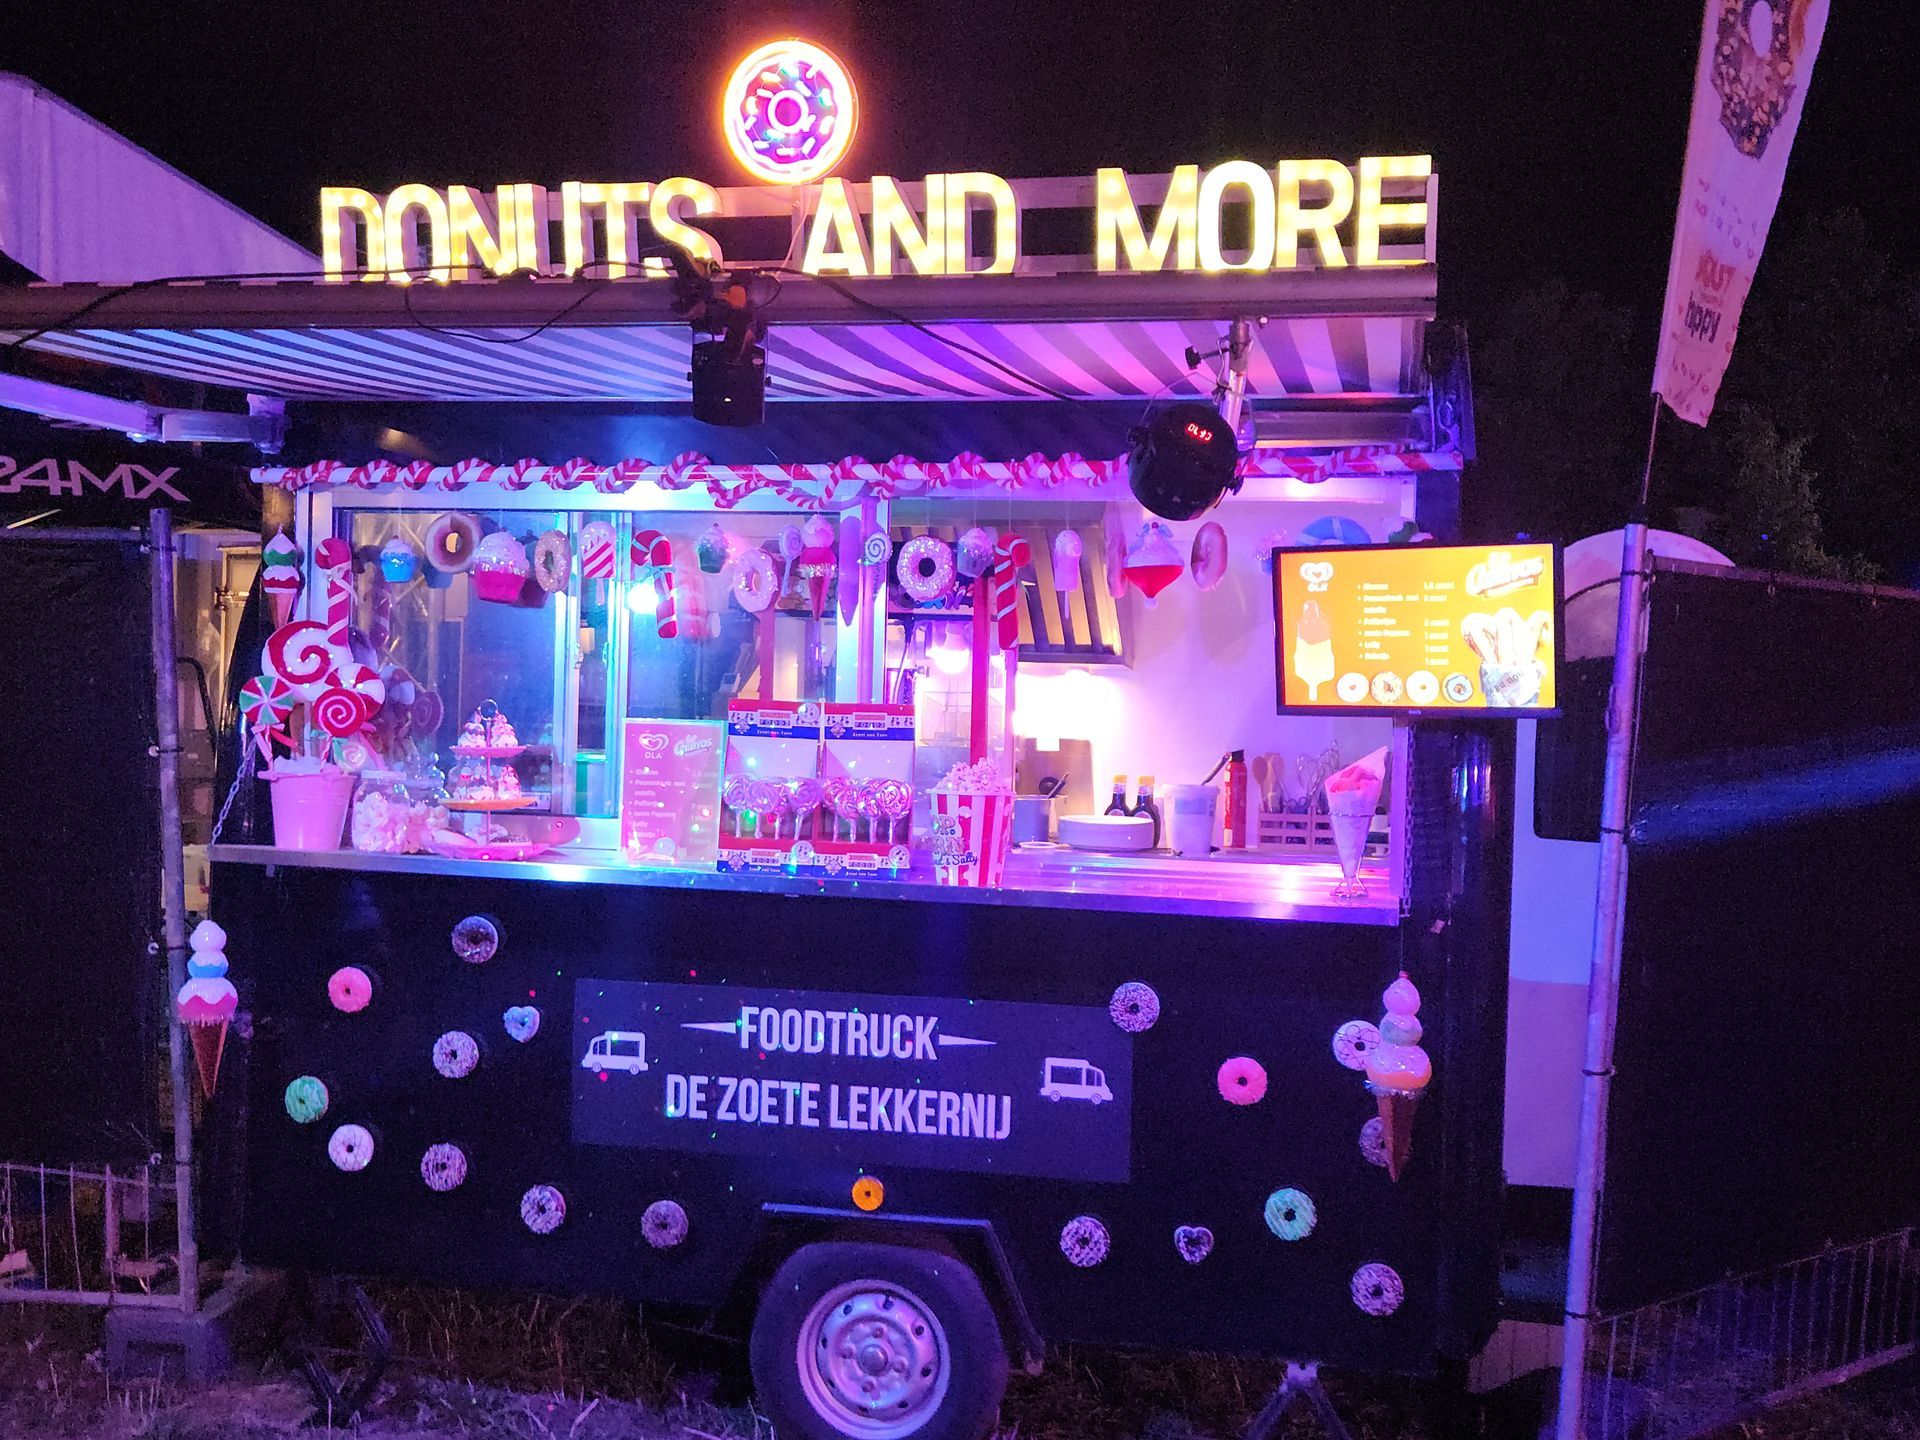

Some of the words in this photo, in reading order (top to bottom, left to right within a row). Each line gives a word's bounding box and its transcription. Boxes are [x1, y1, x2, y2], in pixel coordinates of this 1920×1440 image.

[321, 177, 724, 283] DONUTS
[801, 172, 1016, 277] AND
[1096, 155, 1433, 272] MORE
[644, 752, 662, 760] OLA
[952, 851, 979, 866] Salty
[740, 1006, 939, 1060] FOODTRUCK
[666, 1073, 708, 1120] DE
[717, 1077, 820, 1128] ZOETE
[830, 1084, 1012, 1140] LEKKERNIJ
